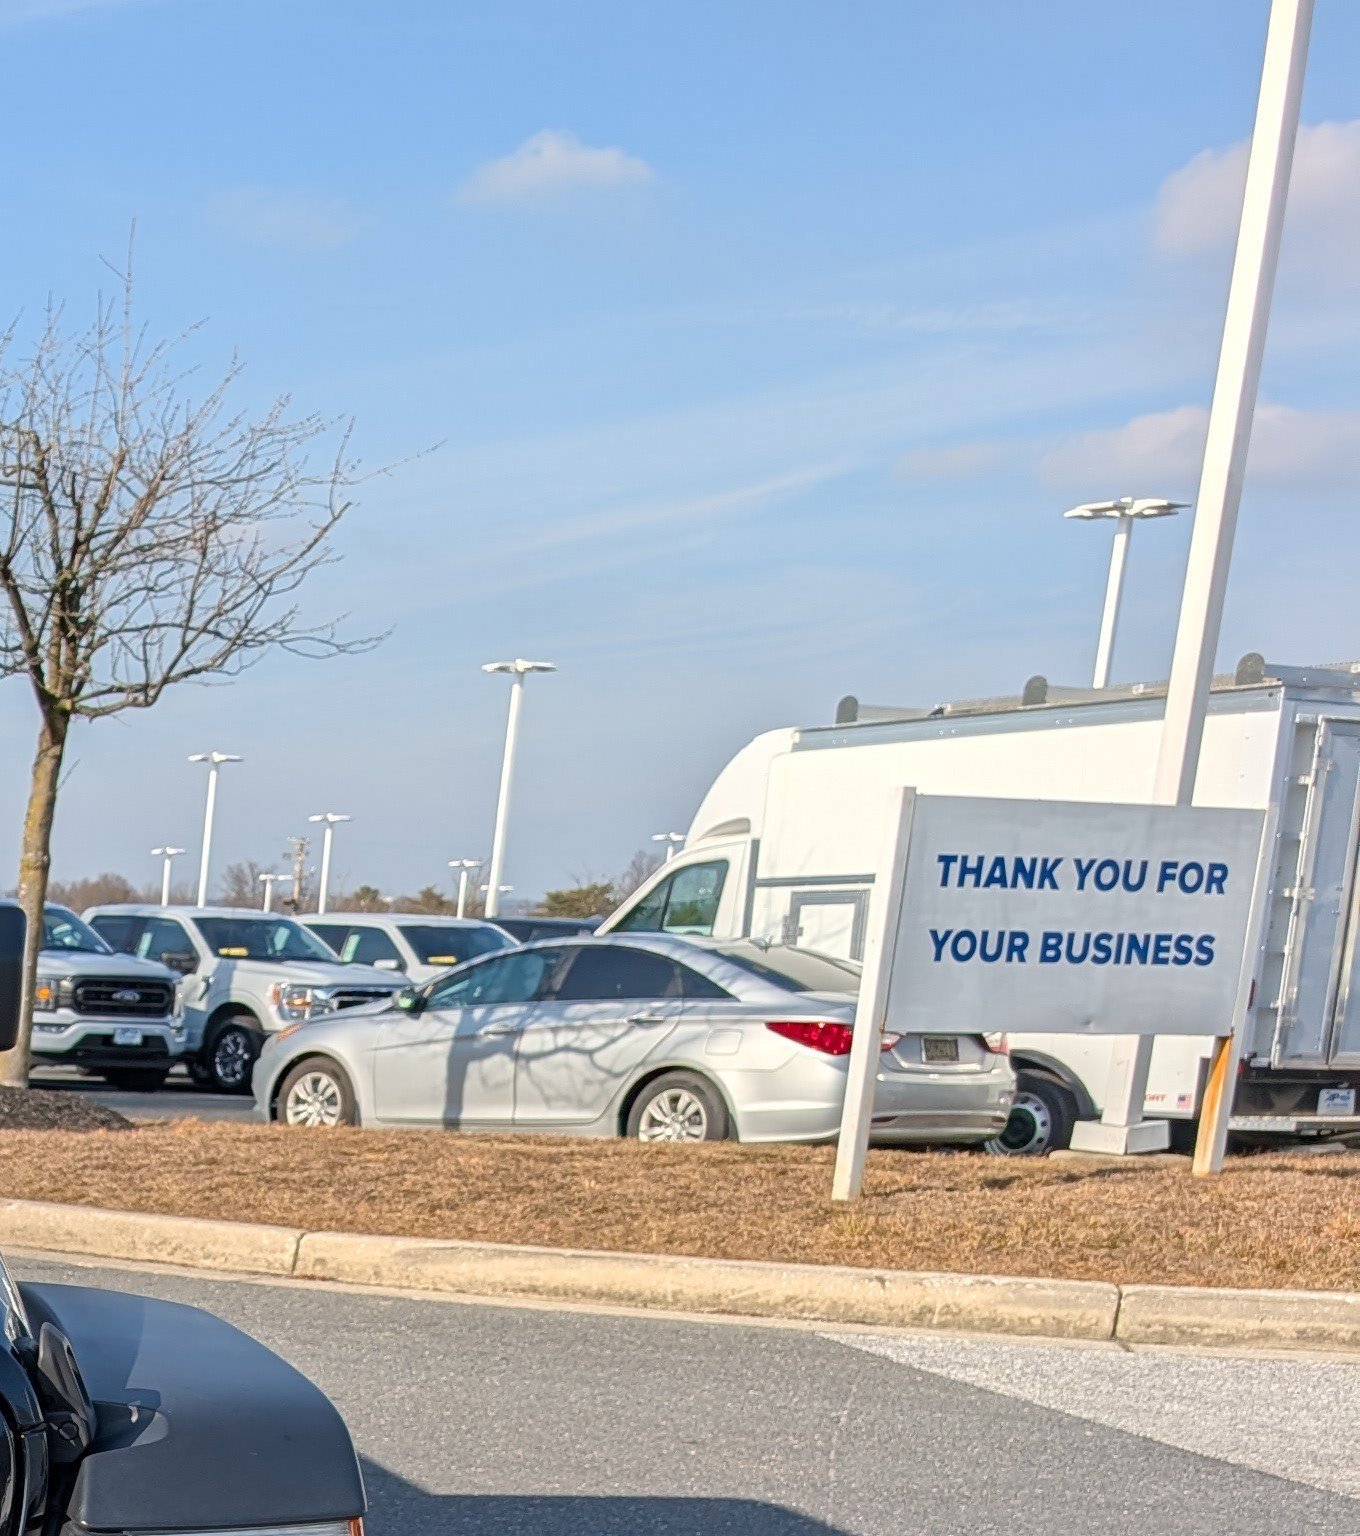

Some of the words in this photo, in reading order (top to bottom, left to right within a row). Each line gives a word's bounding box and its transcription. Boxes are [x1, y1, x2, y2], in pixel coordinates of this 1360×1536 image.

[937, 854, 1063, 890] THANK
[1073, 857, 1149, 893] YOU
[1156, 860, 1229, 895] FOR
[928, 928, 1030, 963] YOUR
[1038, 931, 1216, 966] BUSINESS
